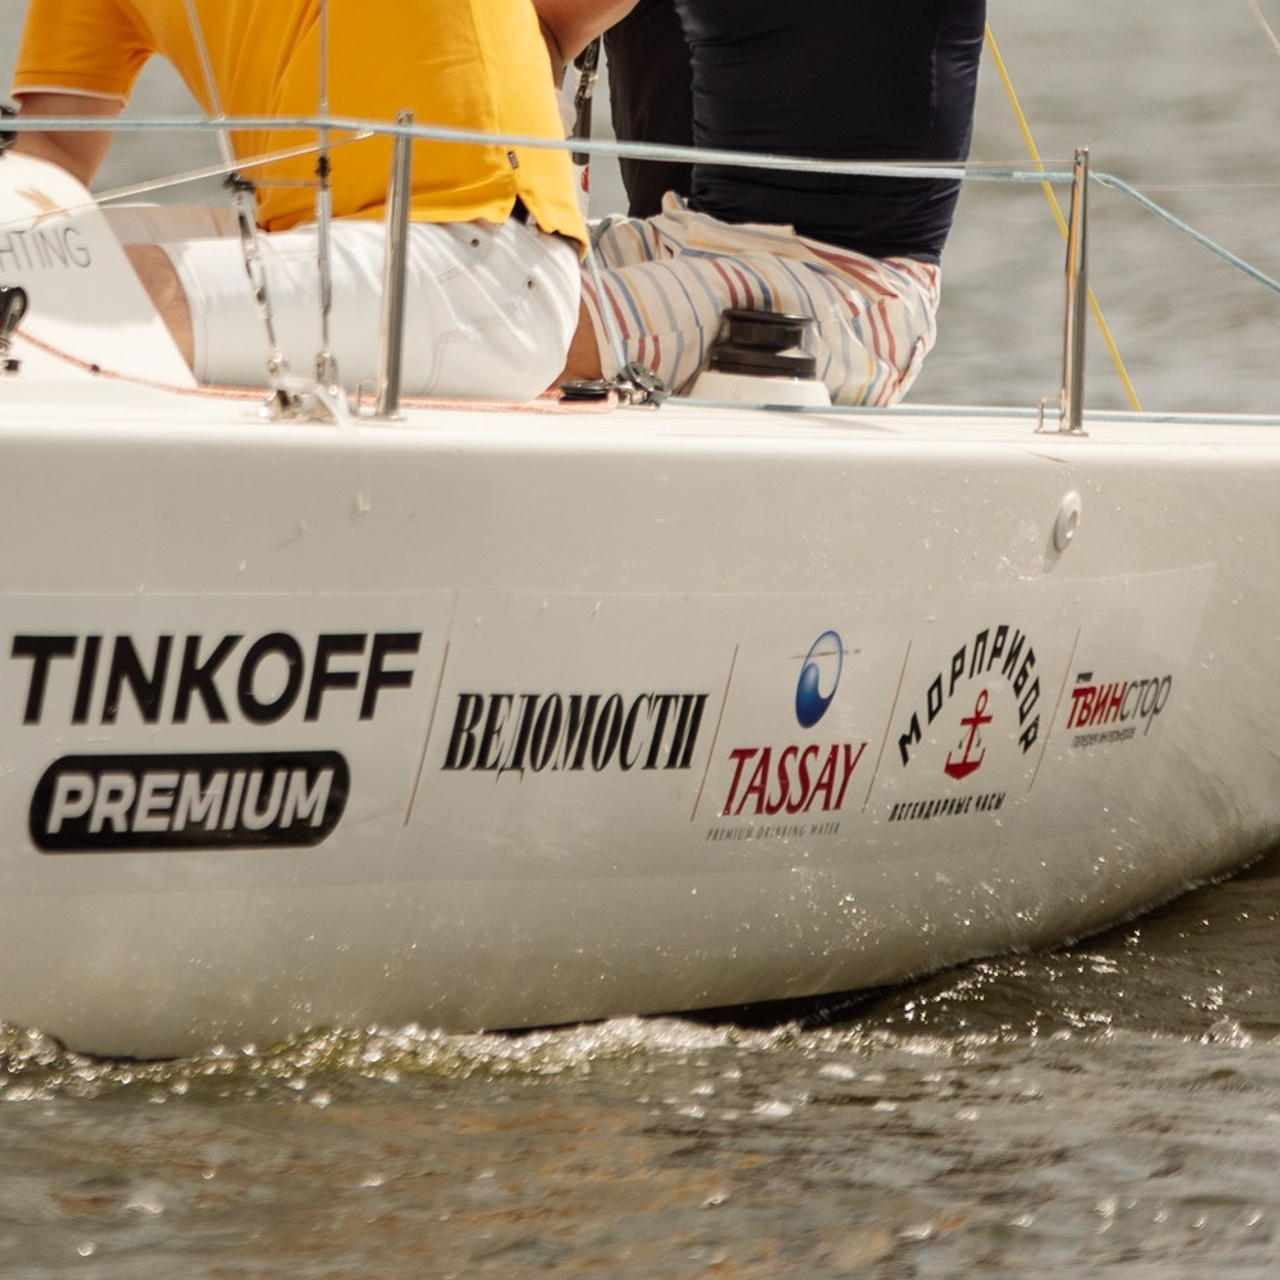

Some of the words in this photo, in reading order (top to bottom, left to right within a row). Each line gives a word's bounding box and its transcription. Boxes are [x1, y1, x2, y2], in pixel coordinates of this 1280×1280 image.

[11, 631, 423, 726] TINKOFF
[898, 625, 1040, 767] МОРПРИБОР
[440, 693, 710, 784] ВЕДОМОСТИ
[722, 742, 868, 816] TASSAY
[45, 767, 336, 835] PREMIUM
[974, 792, 1007, 812] ЧАСЫ
